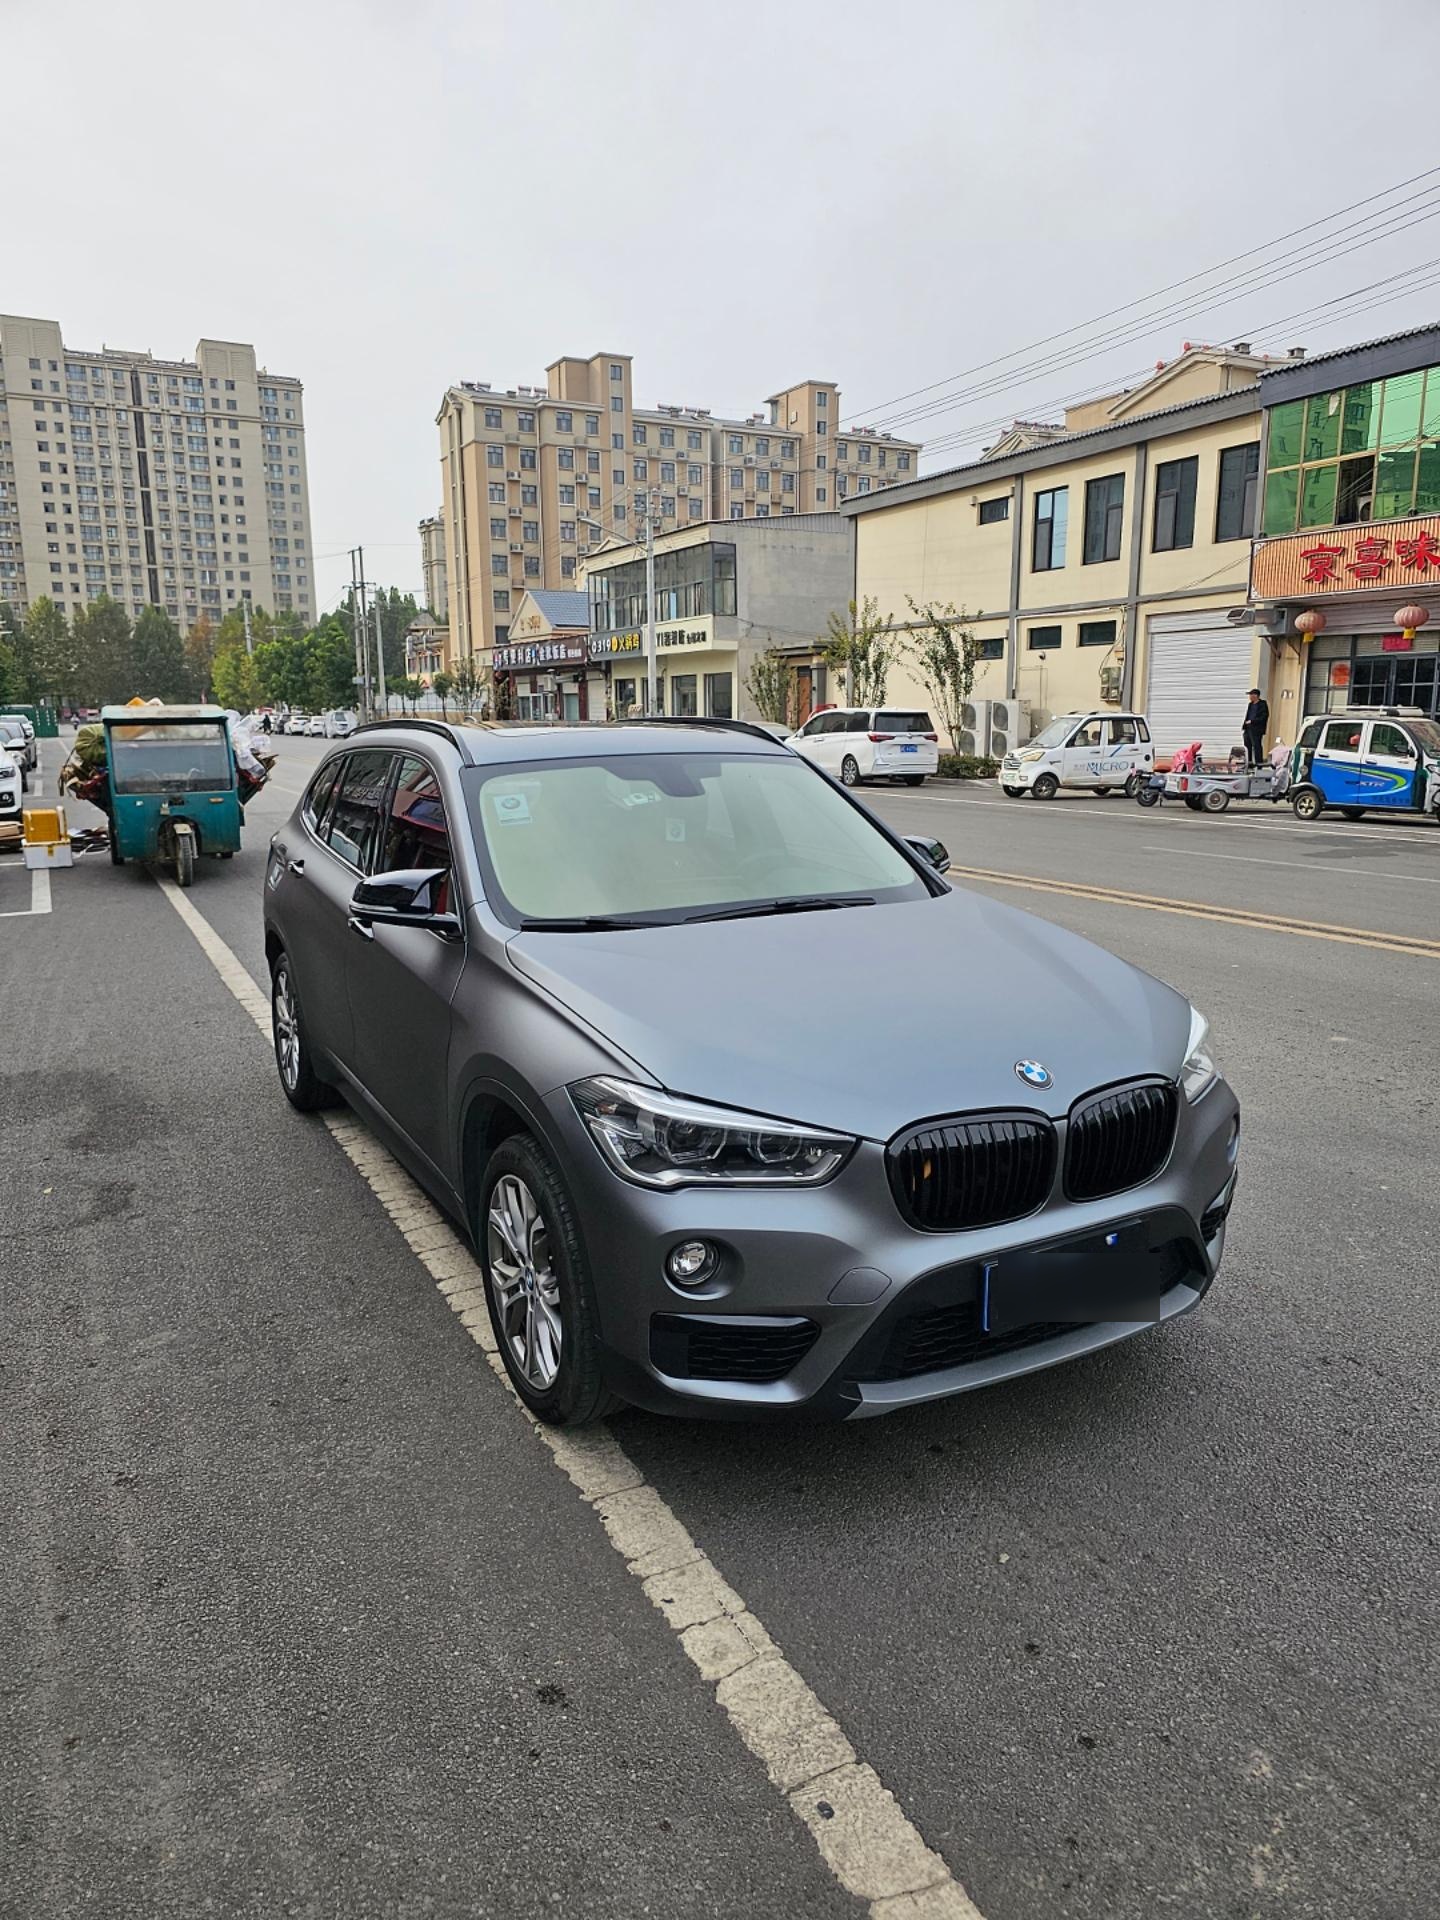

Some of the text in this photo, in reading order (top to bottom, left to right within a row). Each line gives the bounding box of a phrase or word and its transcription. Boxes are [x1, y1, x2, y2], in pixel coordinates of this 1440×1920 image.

[1300, 530, 1440, 584] 京喜味
[591, 638, 611, 653] 0319
[1086, 760, 1129, 772] MICRO
